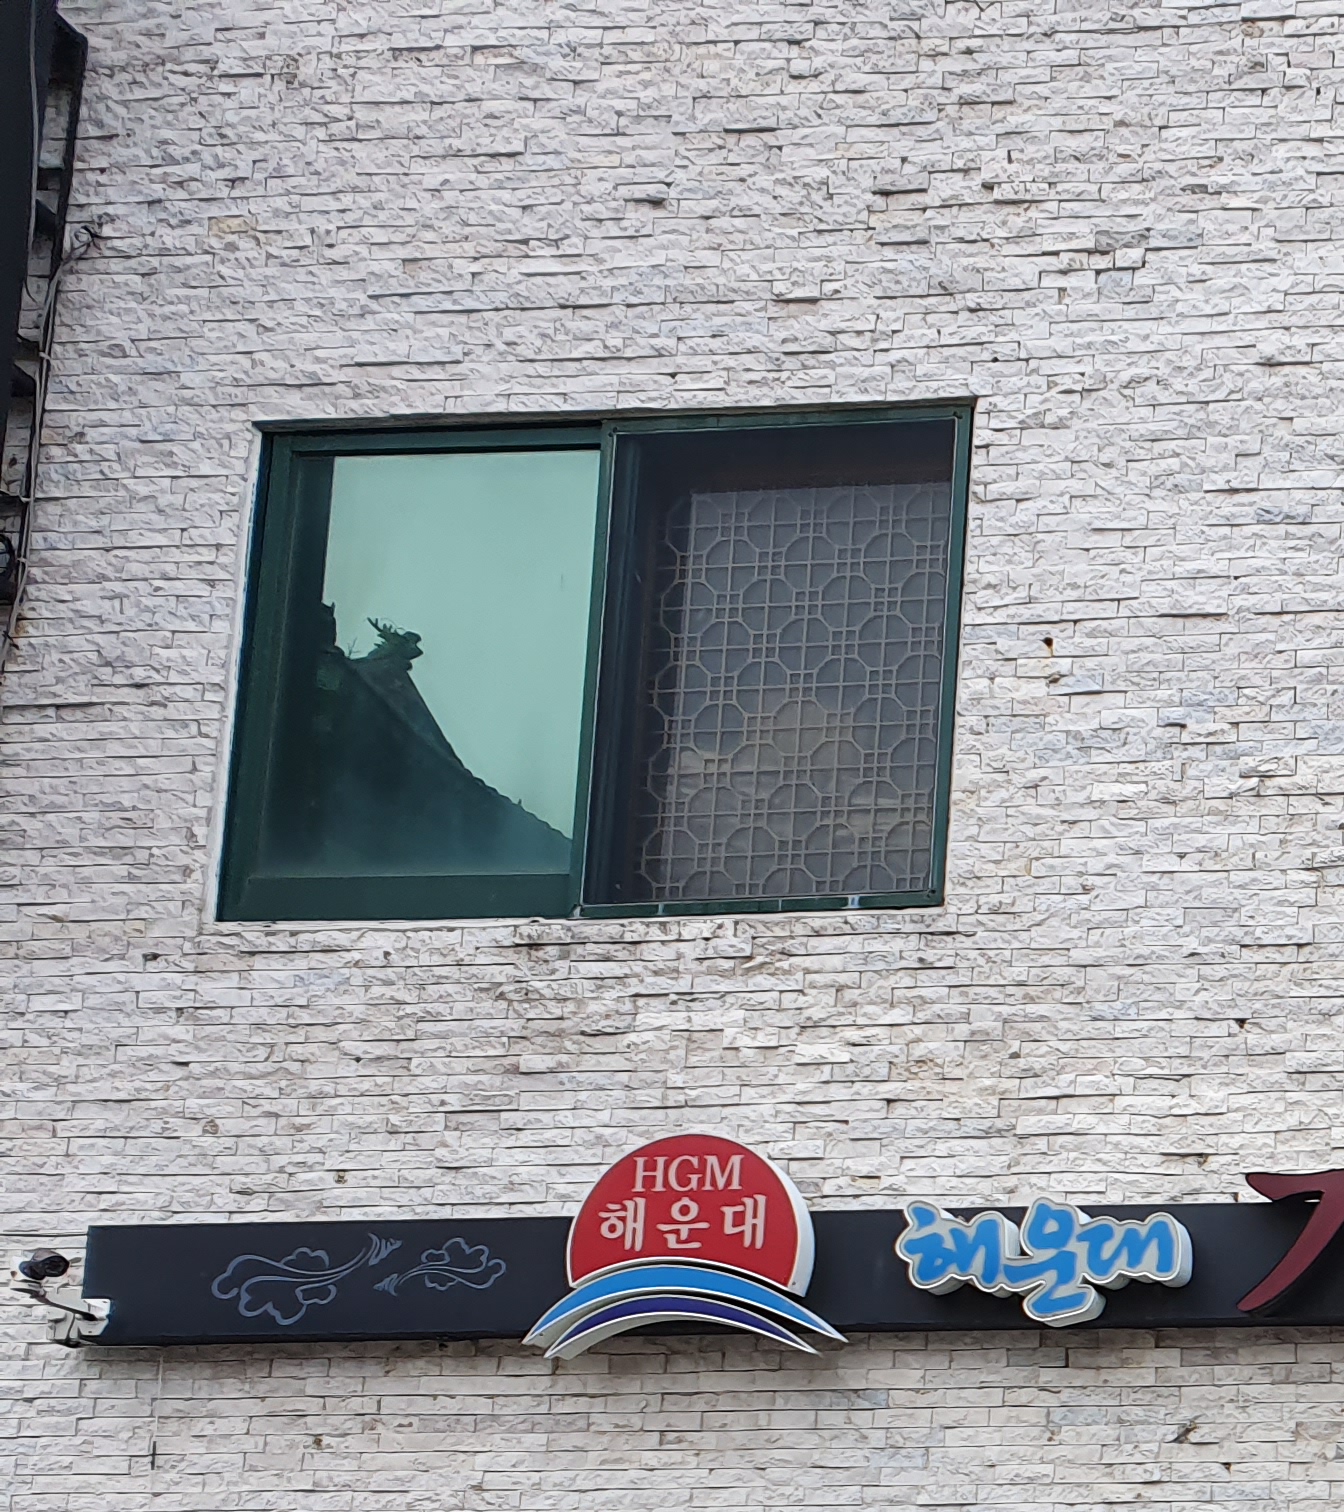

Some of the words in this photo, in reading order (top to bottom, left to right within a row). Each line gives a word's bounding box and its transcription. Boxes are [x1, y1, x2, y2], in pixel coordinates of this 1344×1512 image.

[631, 1154, 745, 1193] HGM
[598, 1194, 767, 1252] 해운대
[898, 1198, 1182, 1320] 해운대
